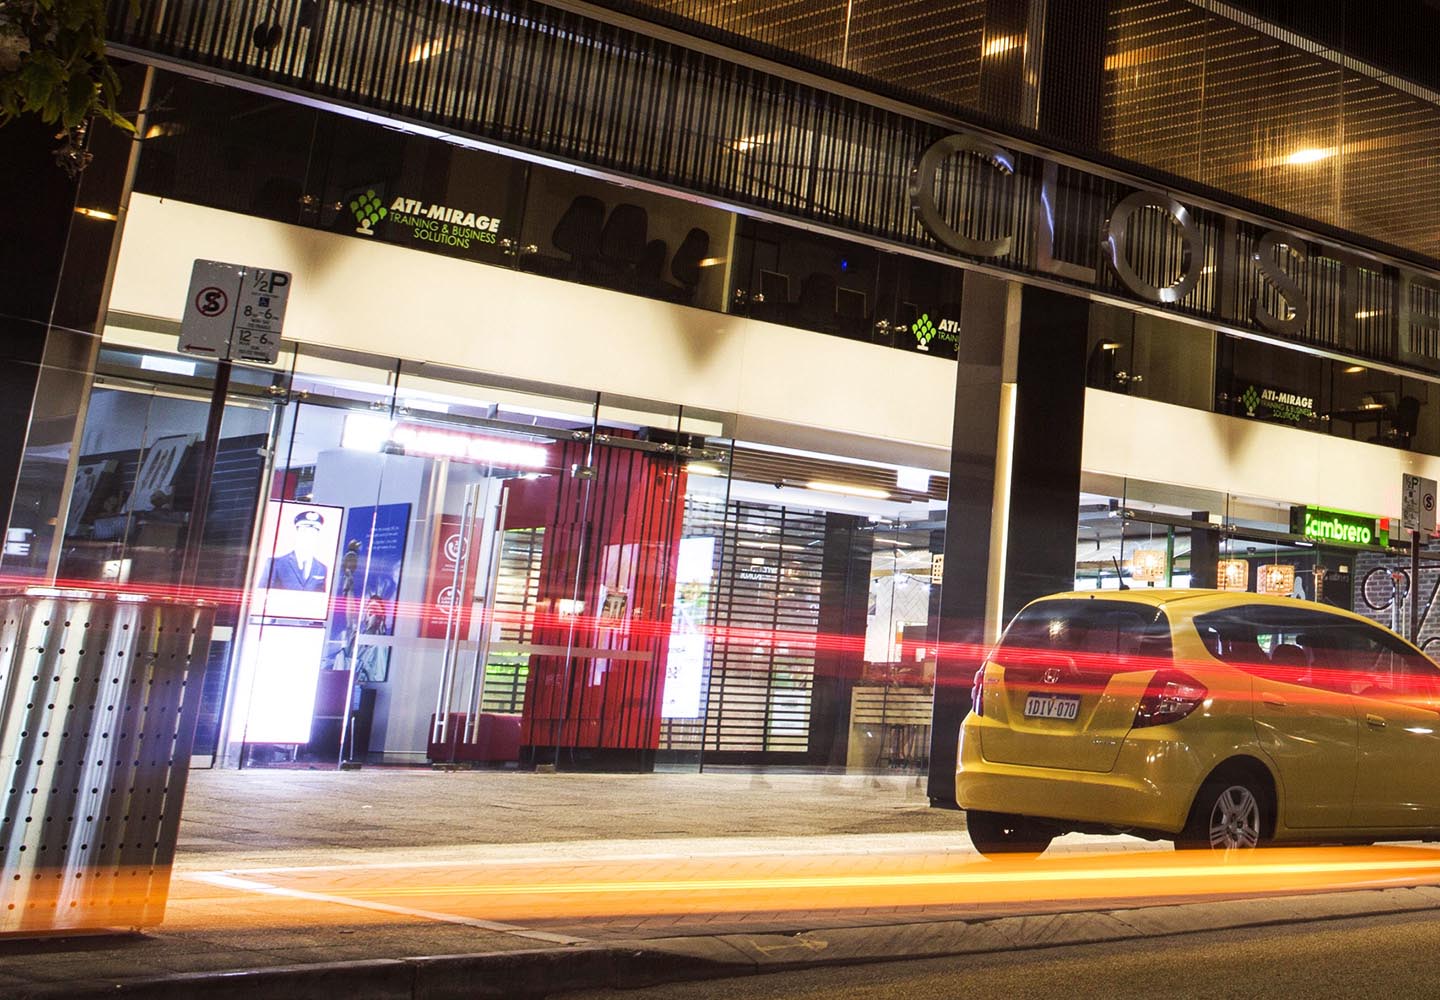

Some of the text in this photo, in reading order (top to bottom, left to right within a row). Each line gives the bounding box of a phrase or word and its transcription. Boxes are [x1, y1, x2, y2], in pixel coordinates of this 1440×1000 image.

[389, 211, 496, 244] TRAINING & BUSINESS
[390, 197, 501, 233] ATI-MIRAGE
[413, 227, 470, 249] SOLUTIONS
[1262, 389, 1313, 409] ATI-MIRAGE
